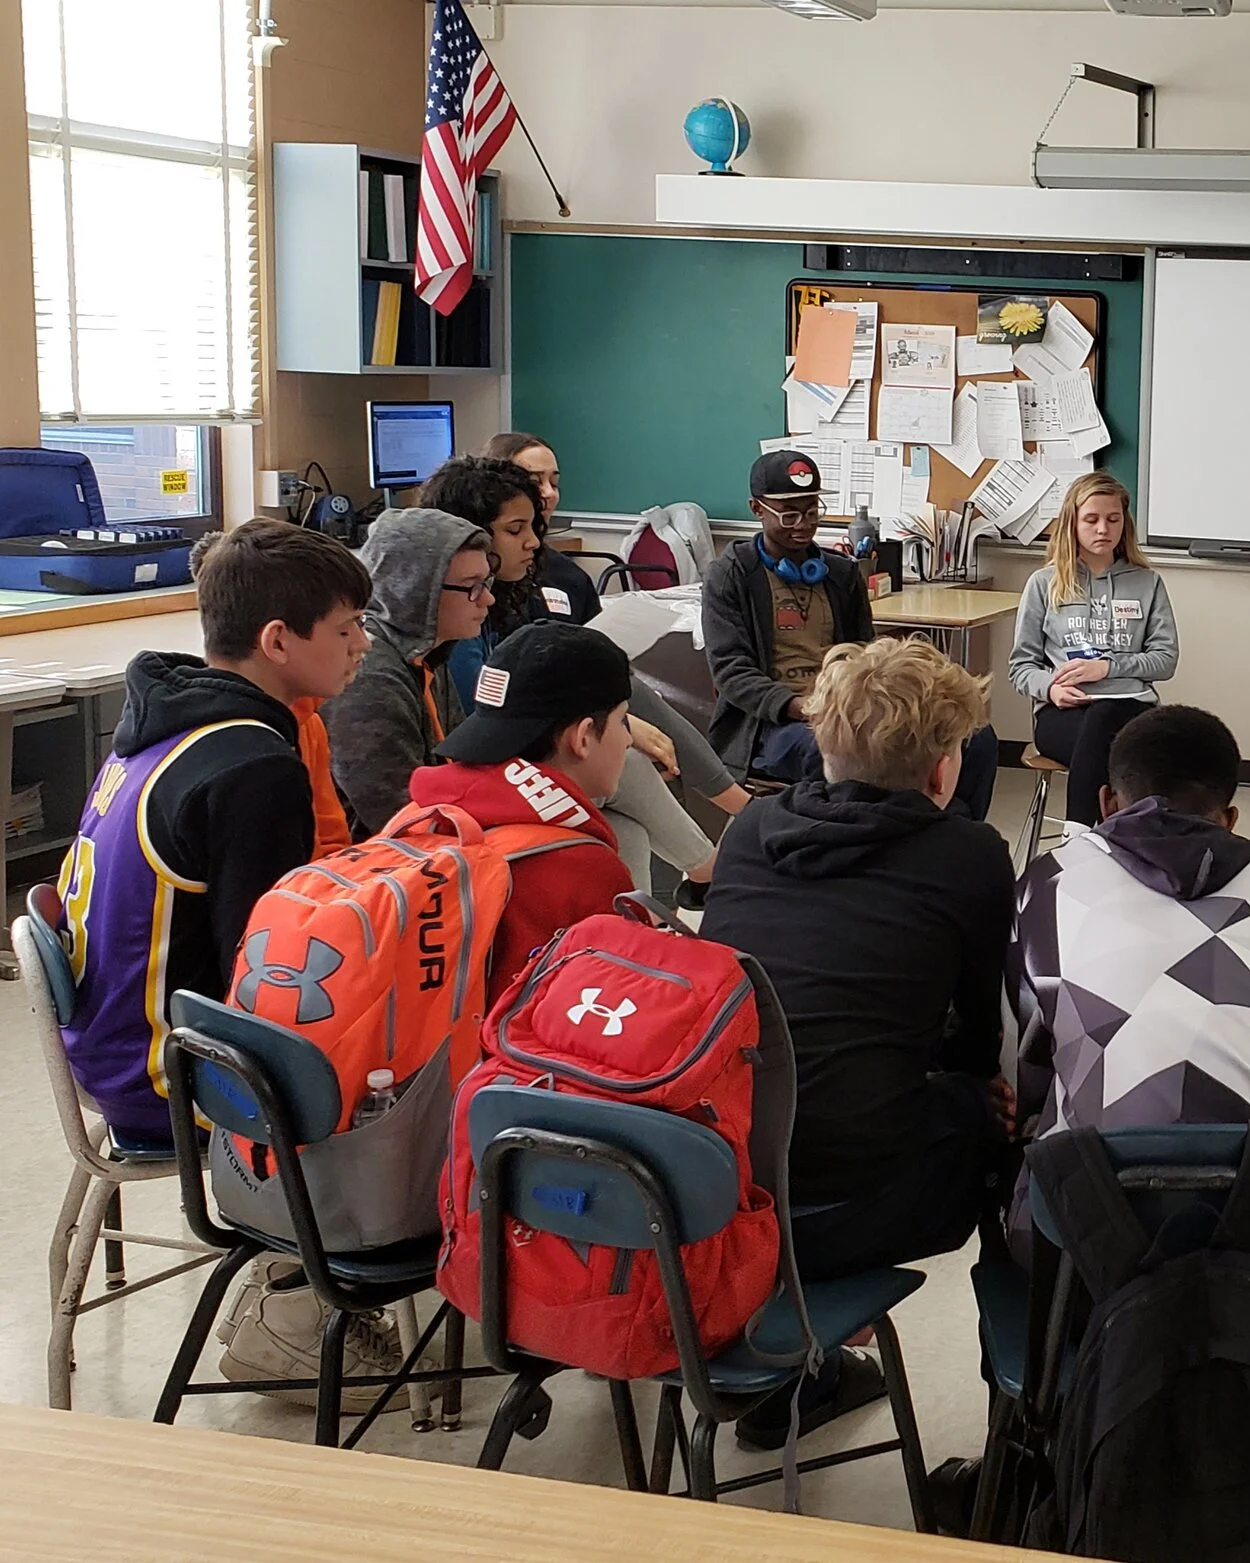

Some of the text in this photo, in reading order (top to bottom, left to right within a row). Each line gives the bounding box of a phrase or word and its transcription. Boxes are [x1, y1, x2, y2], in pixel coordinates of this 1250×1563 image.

[163, 473, 185, 481] RESCUE
[162, 482, 187, 491] WINDOW
[1067, 616, 1128, 630] ROCHESER
[1095, 632, 1133, 647] HOKEY
